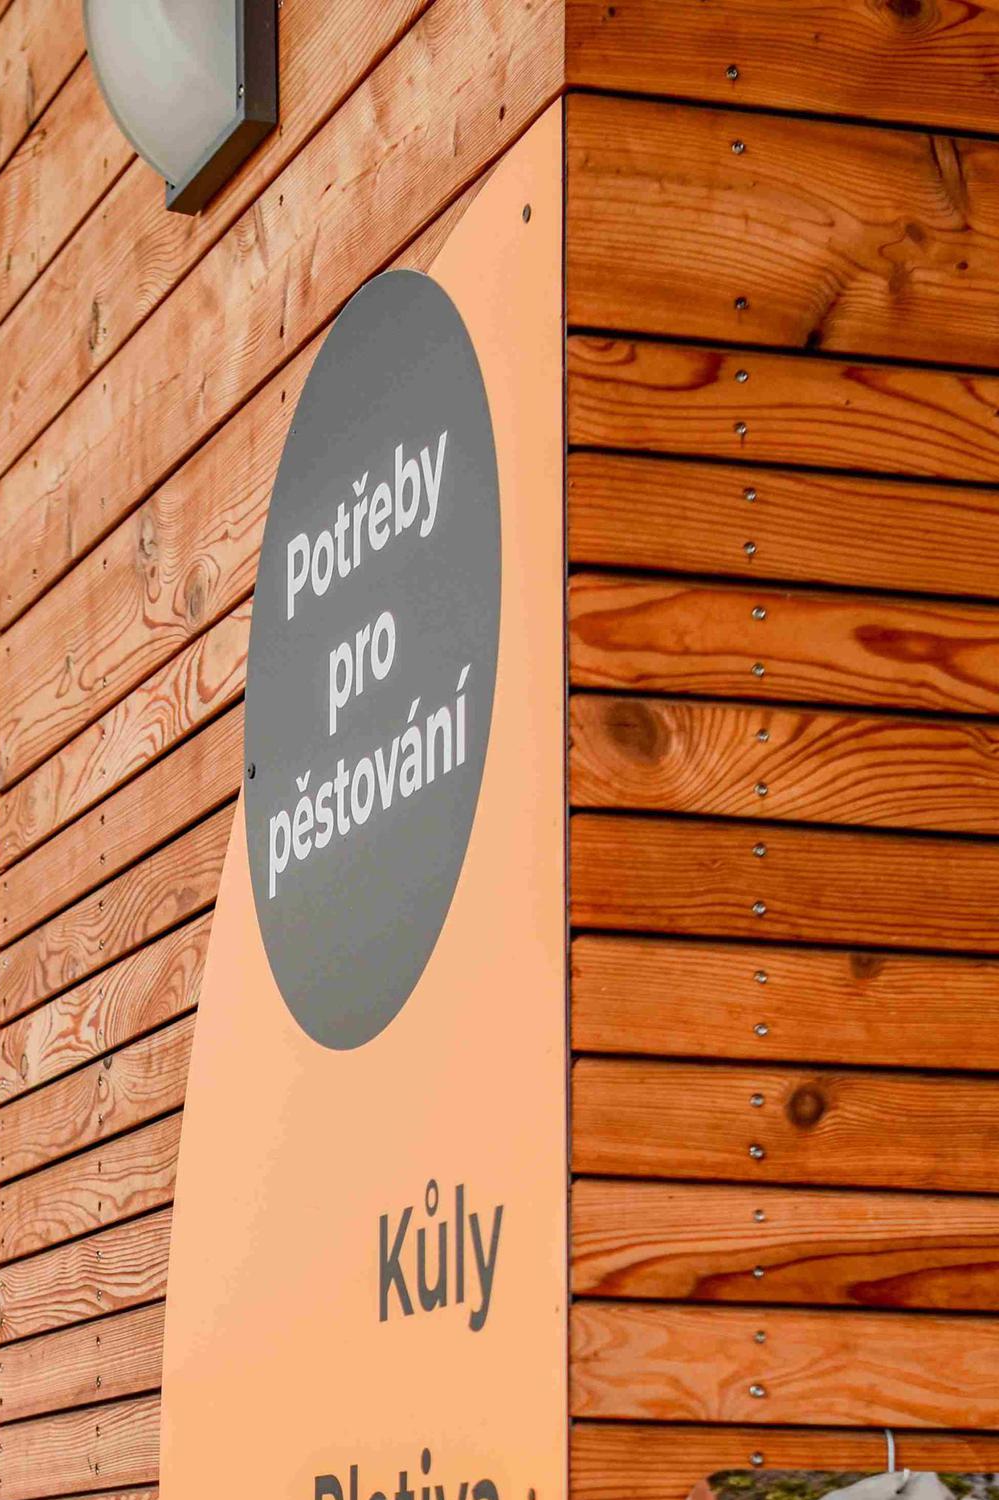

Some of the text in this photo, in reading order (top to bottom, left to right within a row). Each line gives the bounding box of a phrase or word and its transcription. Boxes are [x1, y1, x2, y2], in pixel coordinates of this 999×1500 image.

[287, 430, 448, 621] Potřeby
[329, 610, 396, 737] pro
[268, 663, 471, 900] pěstování
[378, 1178, 504, 1332] Kůly
